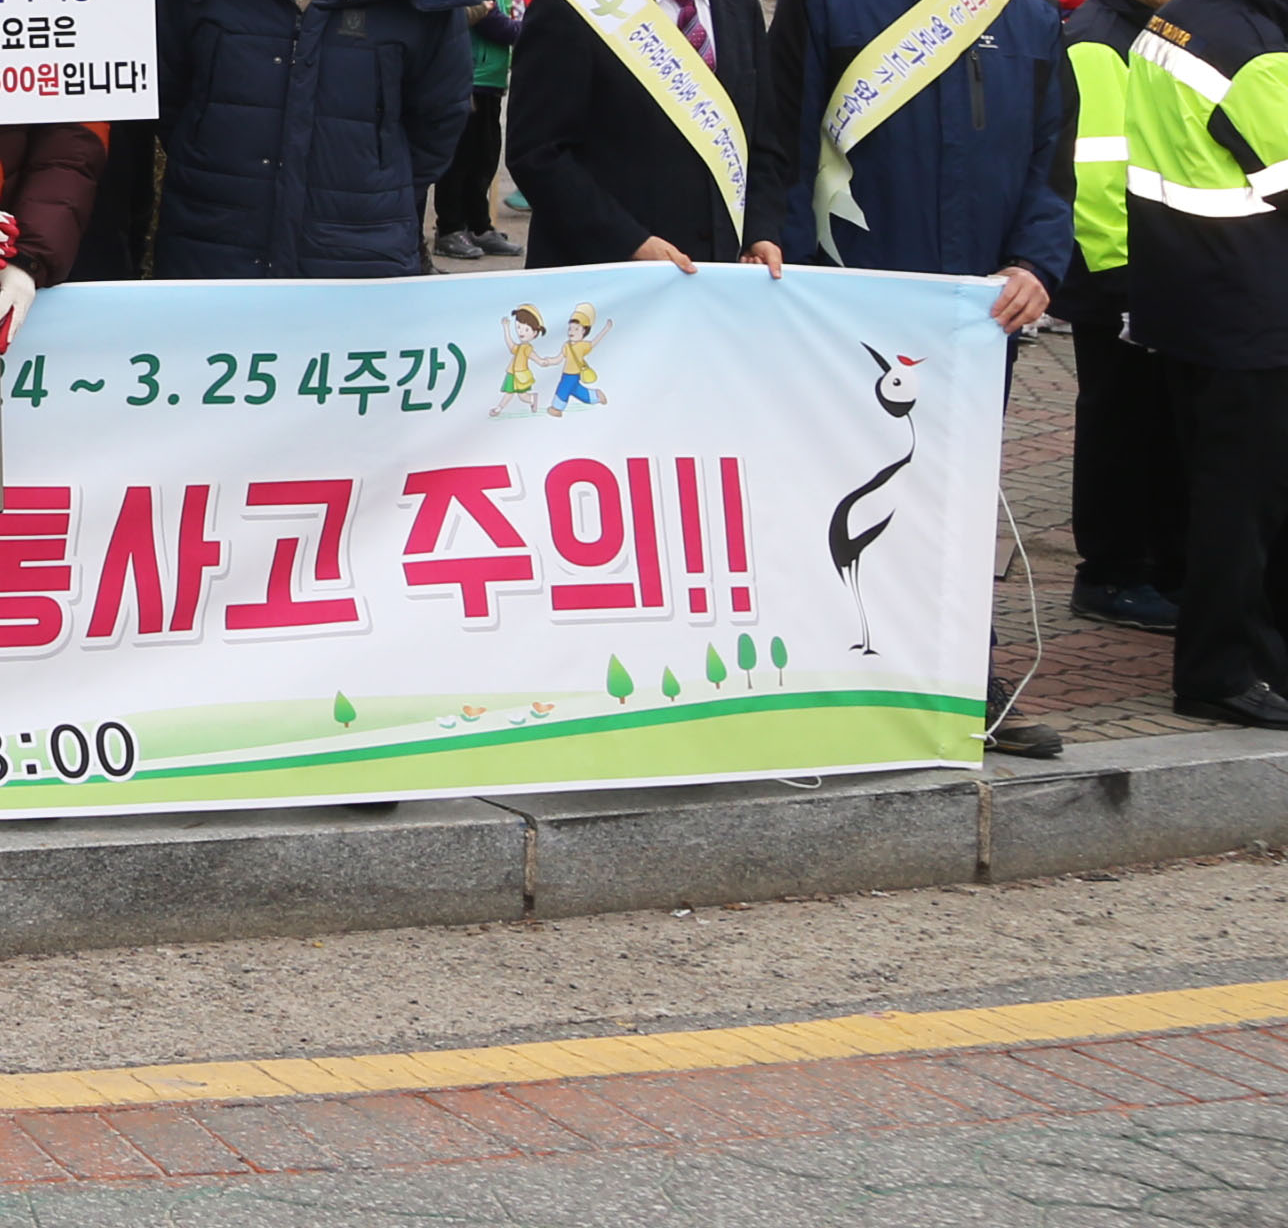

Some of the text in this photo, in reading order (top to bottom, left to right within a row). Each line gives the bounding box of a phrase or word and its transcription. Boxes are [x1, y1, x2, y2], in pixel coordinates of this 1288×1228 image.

[873, 14, 954, 86] 옐로카드가
[201, 352, 278, 406] 25
[297, 341, 468, 417] 4주간)
[401, 456, 753, 619] 주의!!
